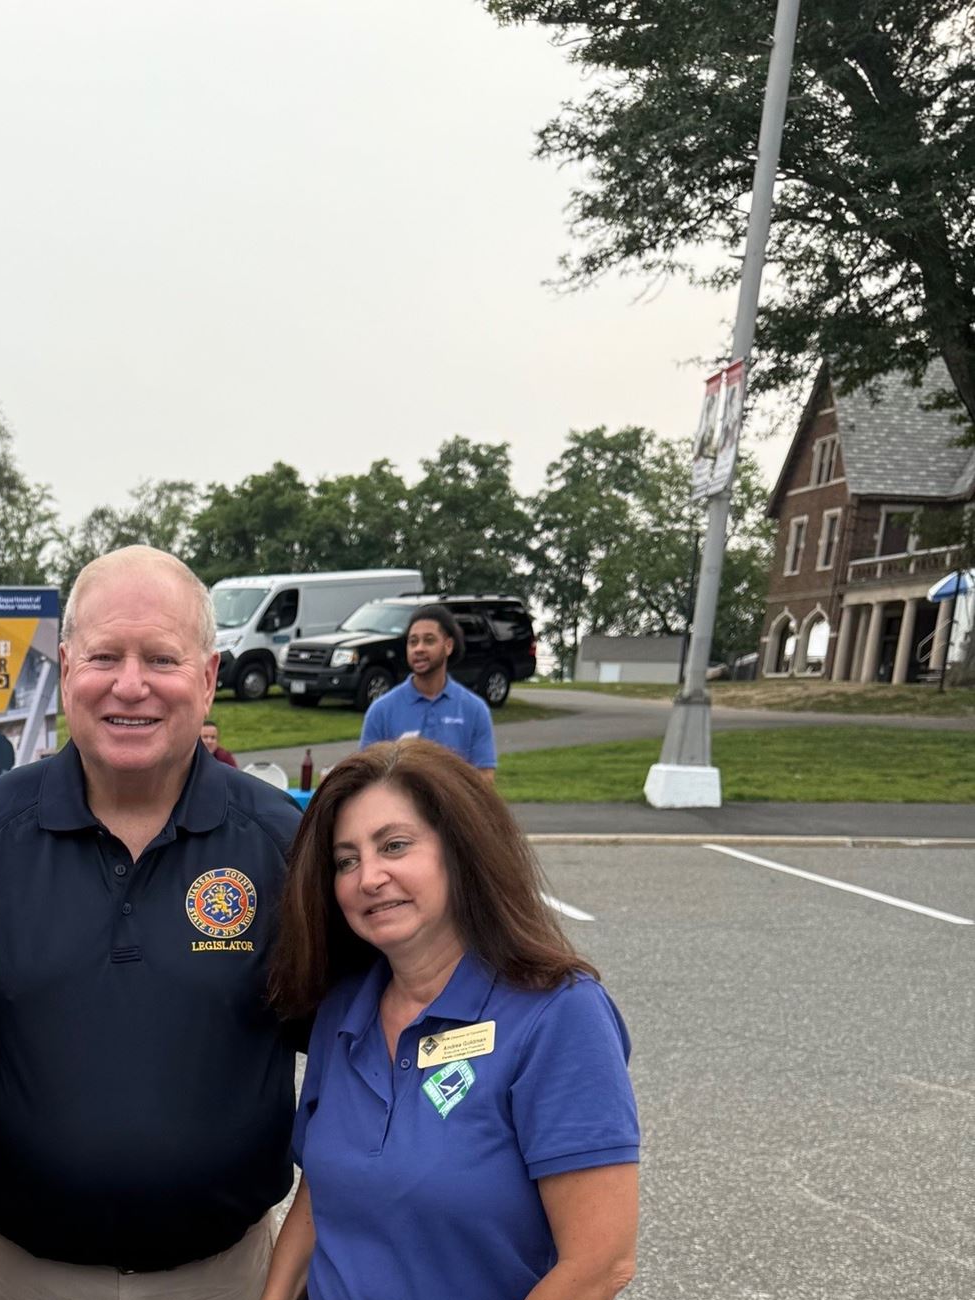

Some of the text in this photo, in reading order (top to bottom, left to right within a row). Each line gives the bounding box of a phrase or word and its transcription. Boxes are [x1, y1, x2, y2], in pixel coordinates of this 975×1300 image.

[189, 870, 255, 899] NASSAU COUNTY
[188, 906, 255, 936] STATE OF NEW YORK
[192, 941, 254, 951] LEGISLATOR
